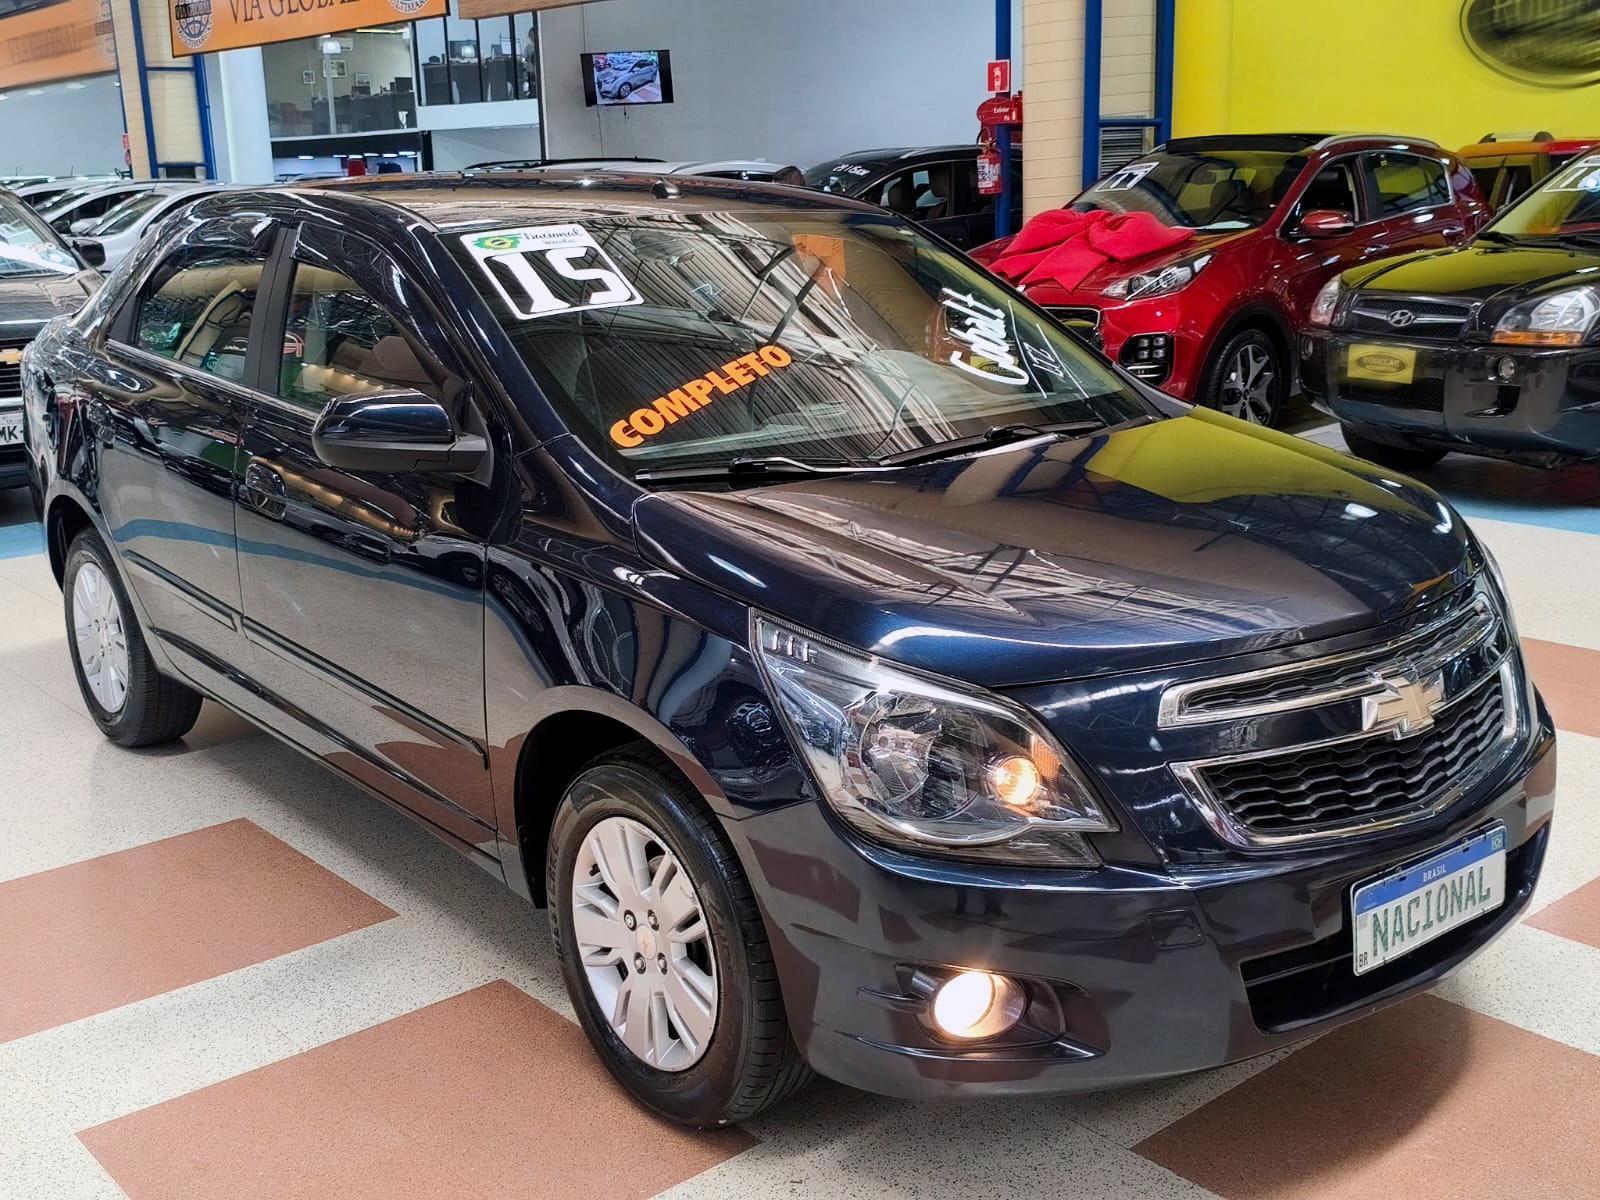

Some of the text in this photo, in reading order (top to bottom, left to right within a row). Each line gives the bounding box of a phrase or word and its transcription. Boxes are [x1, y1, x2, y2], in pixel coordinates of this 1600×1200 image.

[269, 0, 359, 17] GLO
[490, 246, 632, 313] 15
[609, 345, 792, 448] COMPLETO
[1423, 865, 1447, 881] BRASIL
[1372, 866, 1491, 957] NACIONAL
[1359, 952, 1368, 967] BR
